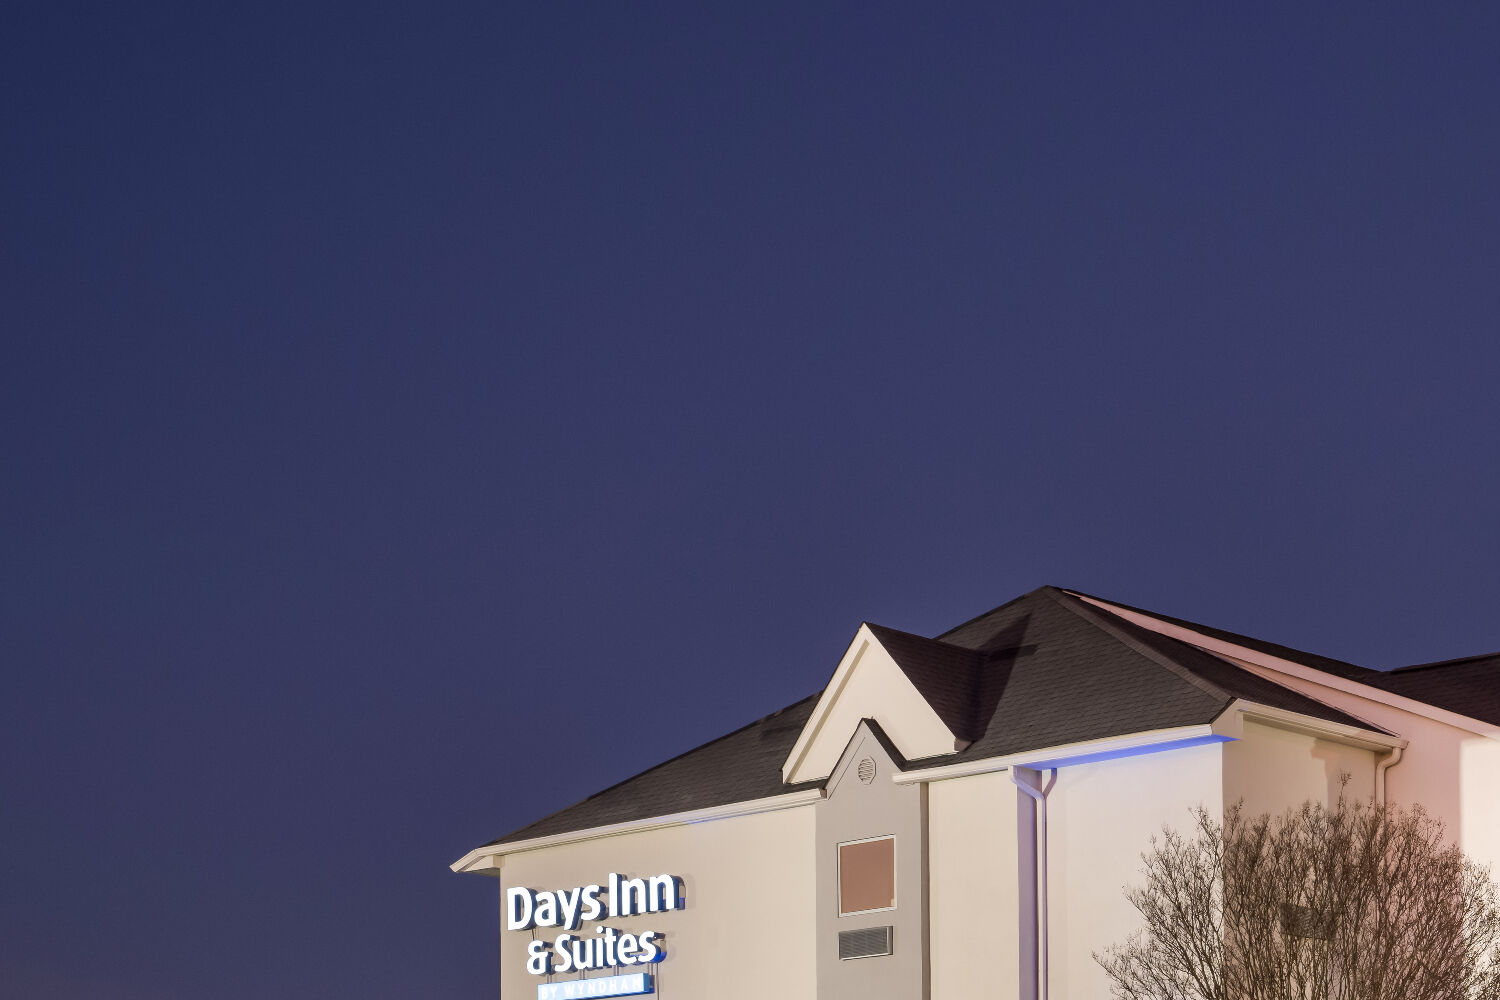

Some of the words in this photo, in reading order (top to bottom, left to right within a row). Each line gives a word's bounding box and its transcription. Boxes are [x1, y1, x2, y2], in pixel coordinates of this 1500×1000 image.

[507, 885, 601, 930] Days
[609, 872, 675, 917] Inn
[526, 940, 549, 974] &
[554, 926, 656, 972] Suites
[541, 986, 558, 999] BY
[564, 977, 641, 997] WYNDHAM
